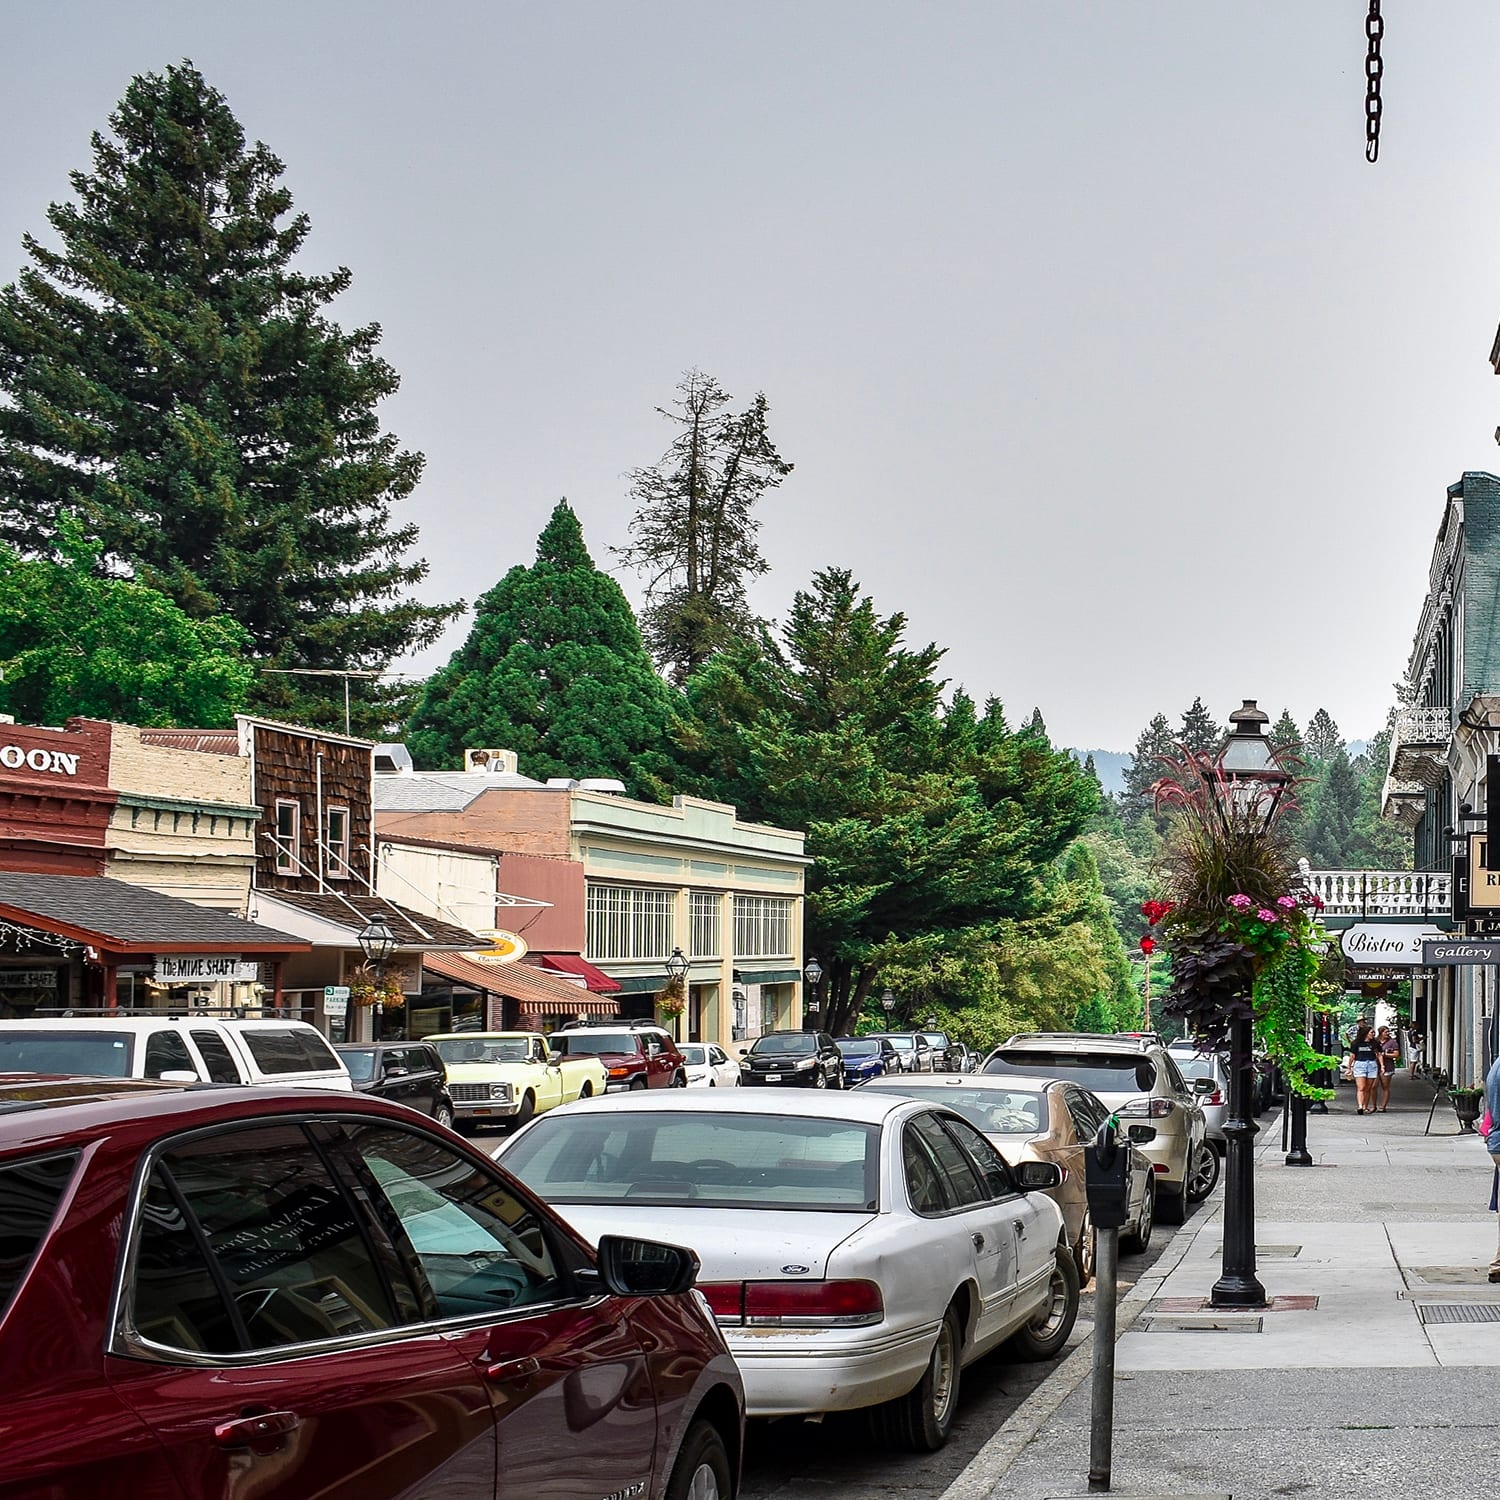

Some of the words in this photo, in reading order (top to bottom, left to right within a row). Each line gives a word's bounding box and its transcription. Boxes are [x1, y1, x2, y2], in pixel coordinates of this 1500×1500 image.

[1348, 932, 1404, 953] Bistro
[1434, 945, 1492, 960] Gallery
[178, 959, 204, 977] MINE
[206, 959, 237, 976] SHAFT
